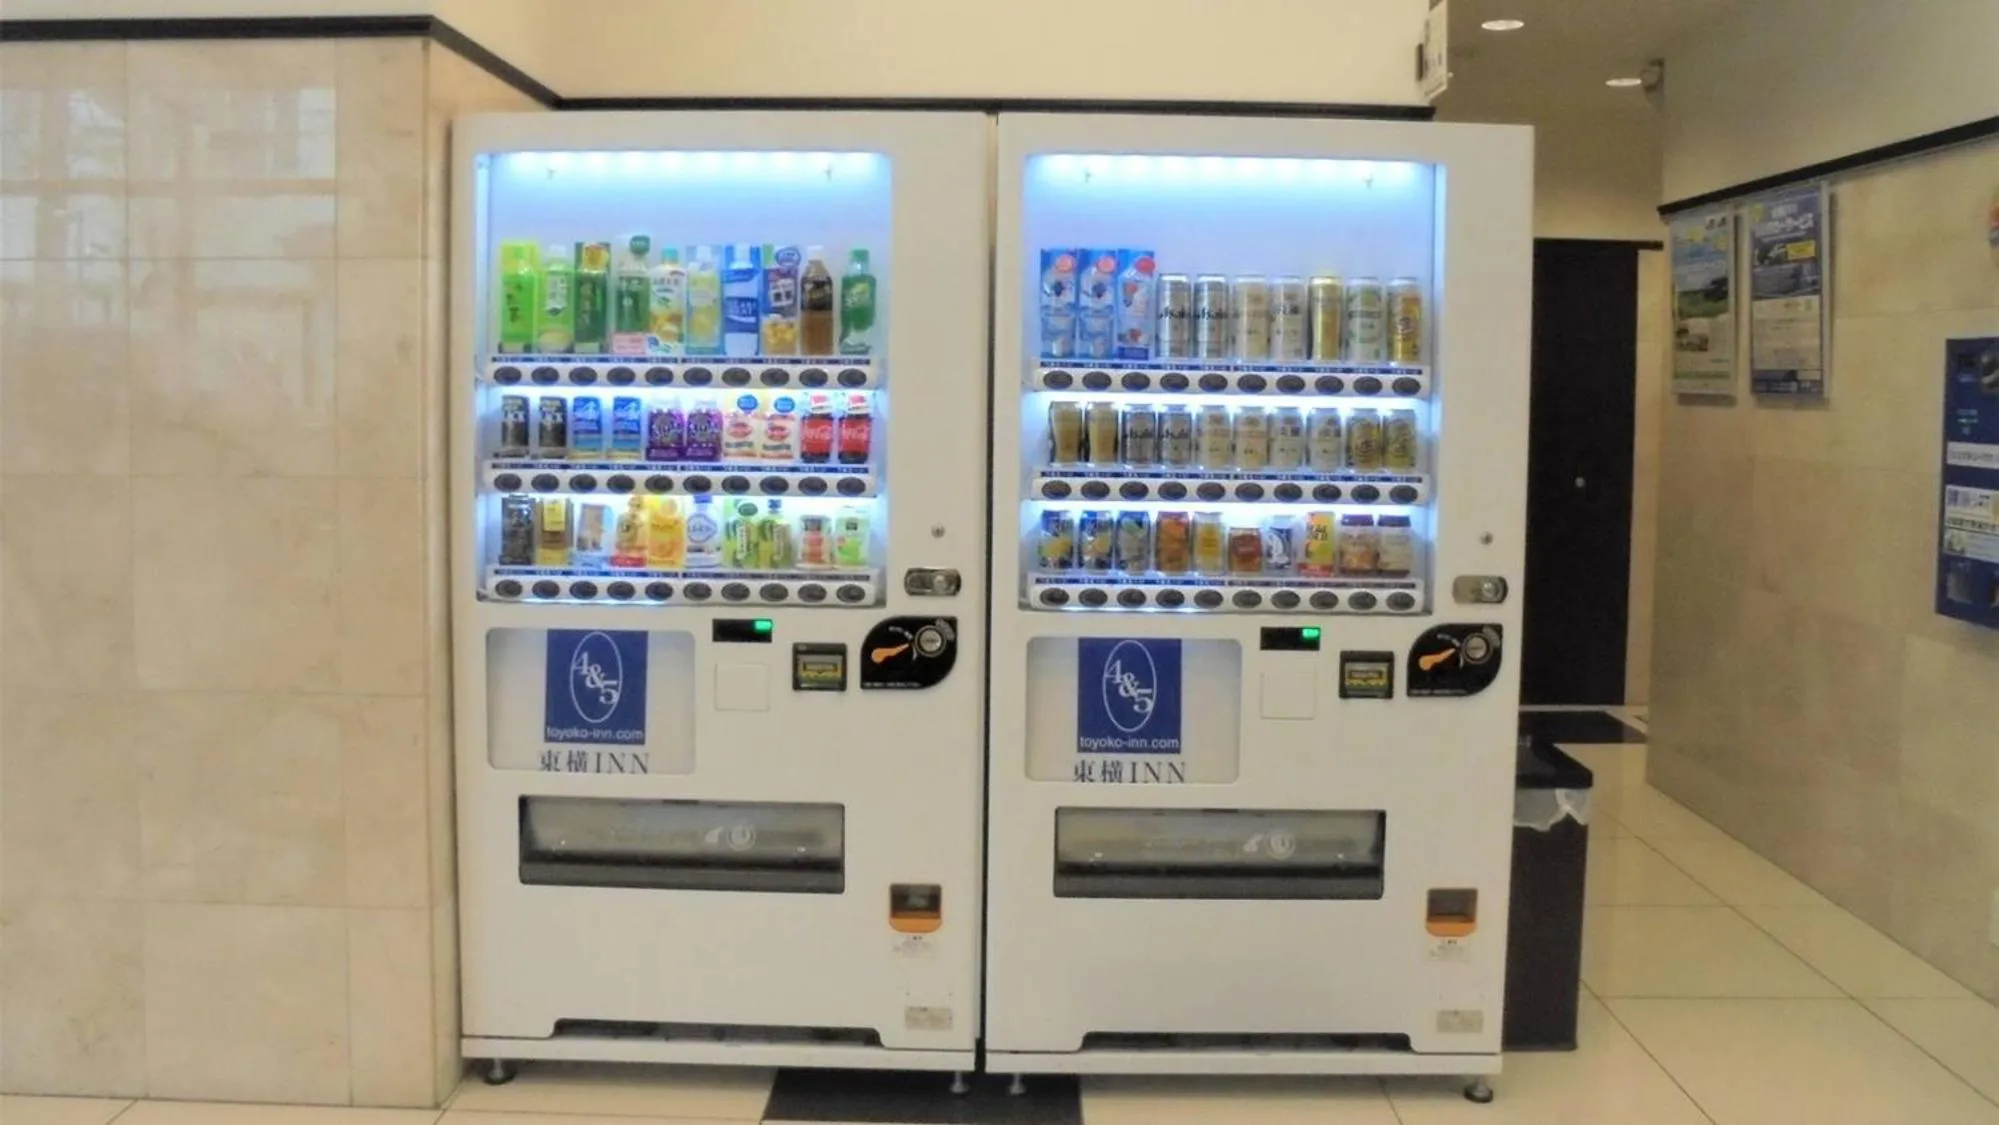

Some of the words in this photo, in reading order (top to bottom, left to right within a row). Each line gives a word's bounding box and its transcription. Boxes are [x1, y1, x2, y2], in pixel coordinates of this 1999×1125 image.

[573, 651, 618, 704] 4&5
[1104, 659, 1154, 713] 4&5
[547, 726, 644, 741] toyoko-inn.com
[1080, 736, 1179, 749] toyoko-inn.com
[1073, 759, 1186, 784] 東横INN
